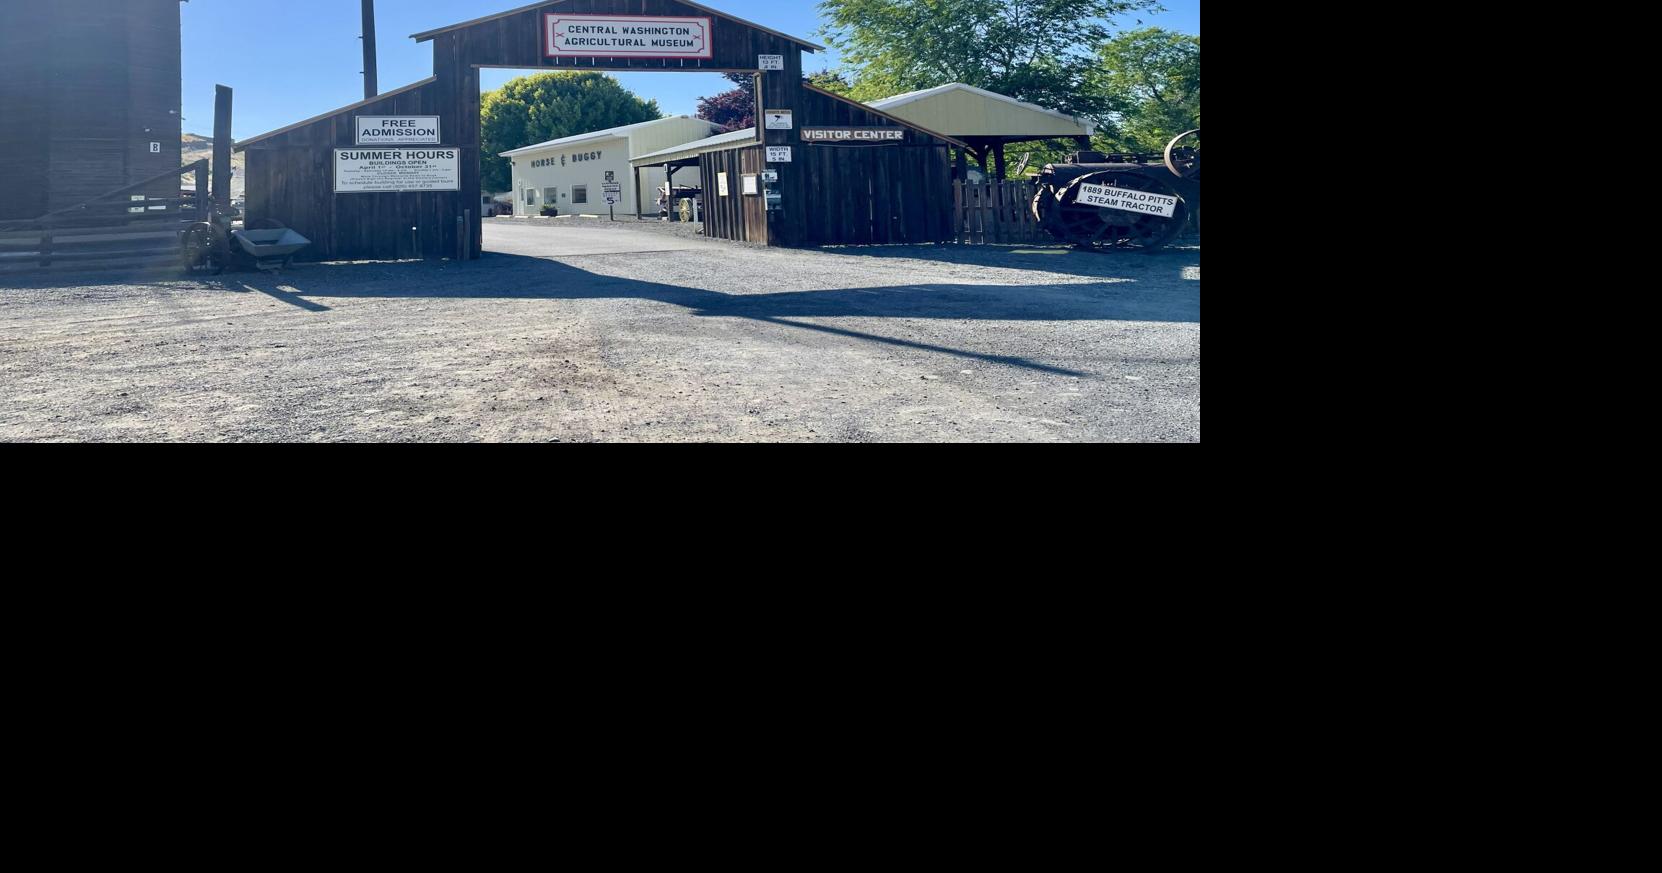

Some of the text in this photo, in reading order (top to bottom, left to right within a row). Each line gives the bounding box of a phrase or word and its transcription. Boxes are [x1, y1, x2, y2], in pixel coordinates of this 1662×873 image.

[568, 26, 690, 35] CENTRAL WASHINGTON
[564, 38, 694, 47] AGRICULTURAL MUSEUM
[804, 130, 903, 139] VISITOR CENTER
[340, 151, 454, 160] SUMMER HOURS
[530, 151, 602, 168] HORSE & BUGGY
[1082, 186, 1174, 206] 1889 BUFFALO PITTS
[1087, 195, 1164, 213] STEAM TRACTOR
